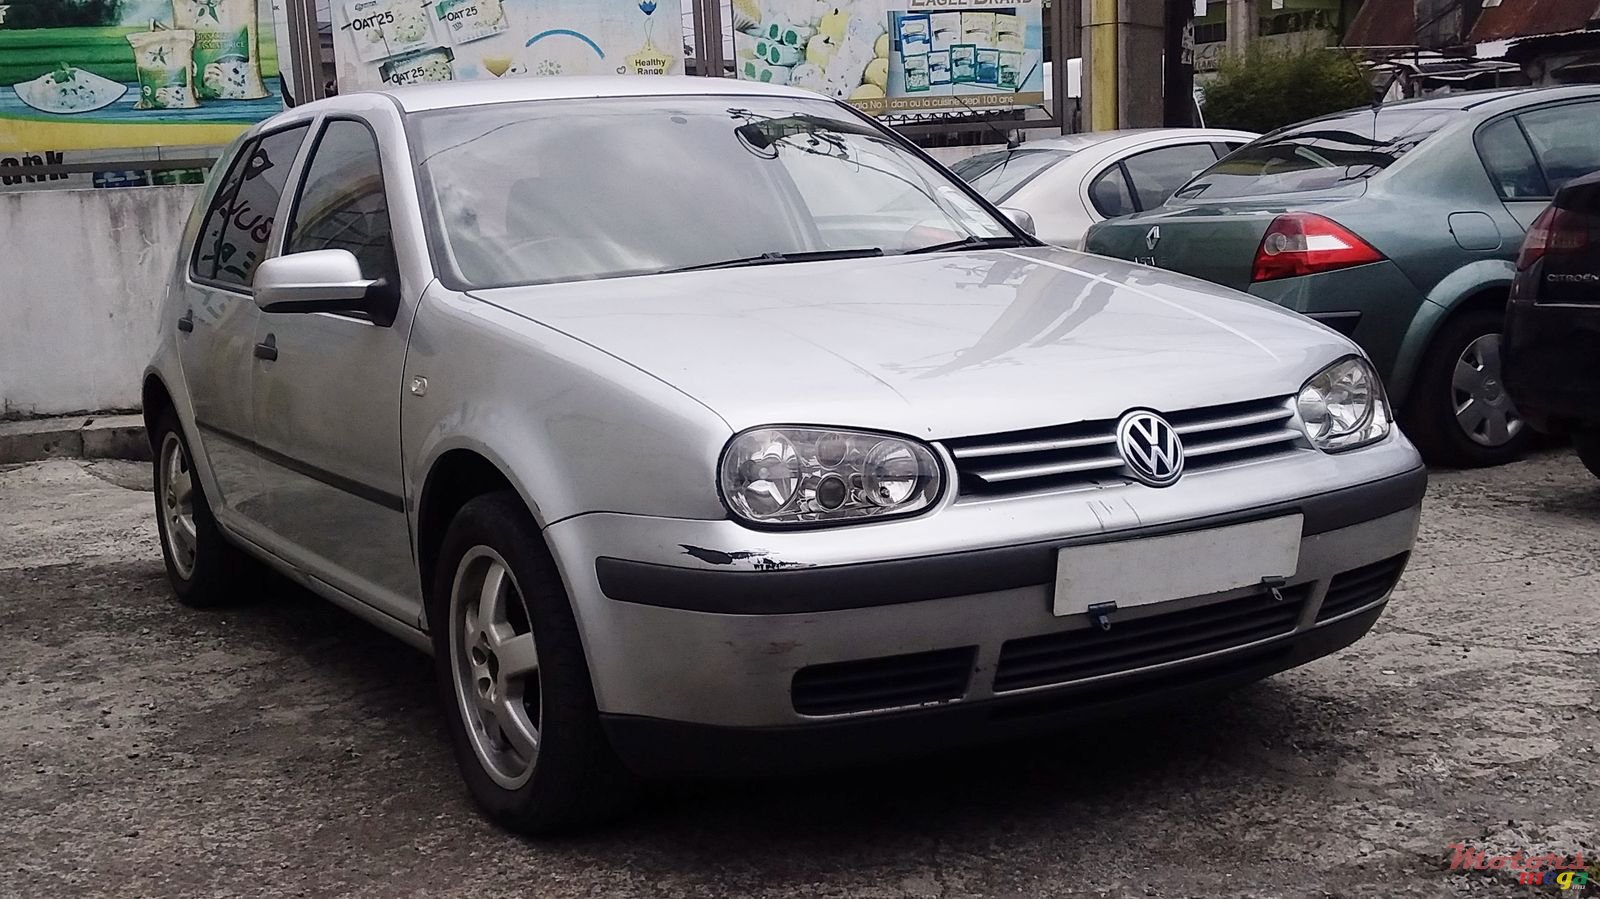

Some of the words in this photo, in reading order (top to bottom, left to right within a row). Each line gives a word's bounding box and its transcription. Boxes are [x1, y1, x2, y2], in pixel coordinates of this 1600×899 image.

[635, 58, 666, 67] Healthy
[870, 100, 882, 110] No
[891, 99, 908, 109] dan
[909, 99, 921, 108] ou
[922, 98, 931, 107] la
[932, 97, 960, 107] cuisine
[962, 96, 980, 106] depi
[983, 95, 997, 105] 100
[998, 95, 1014, 104] ans
